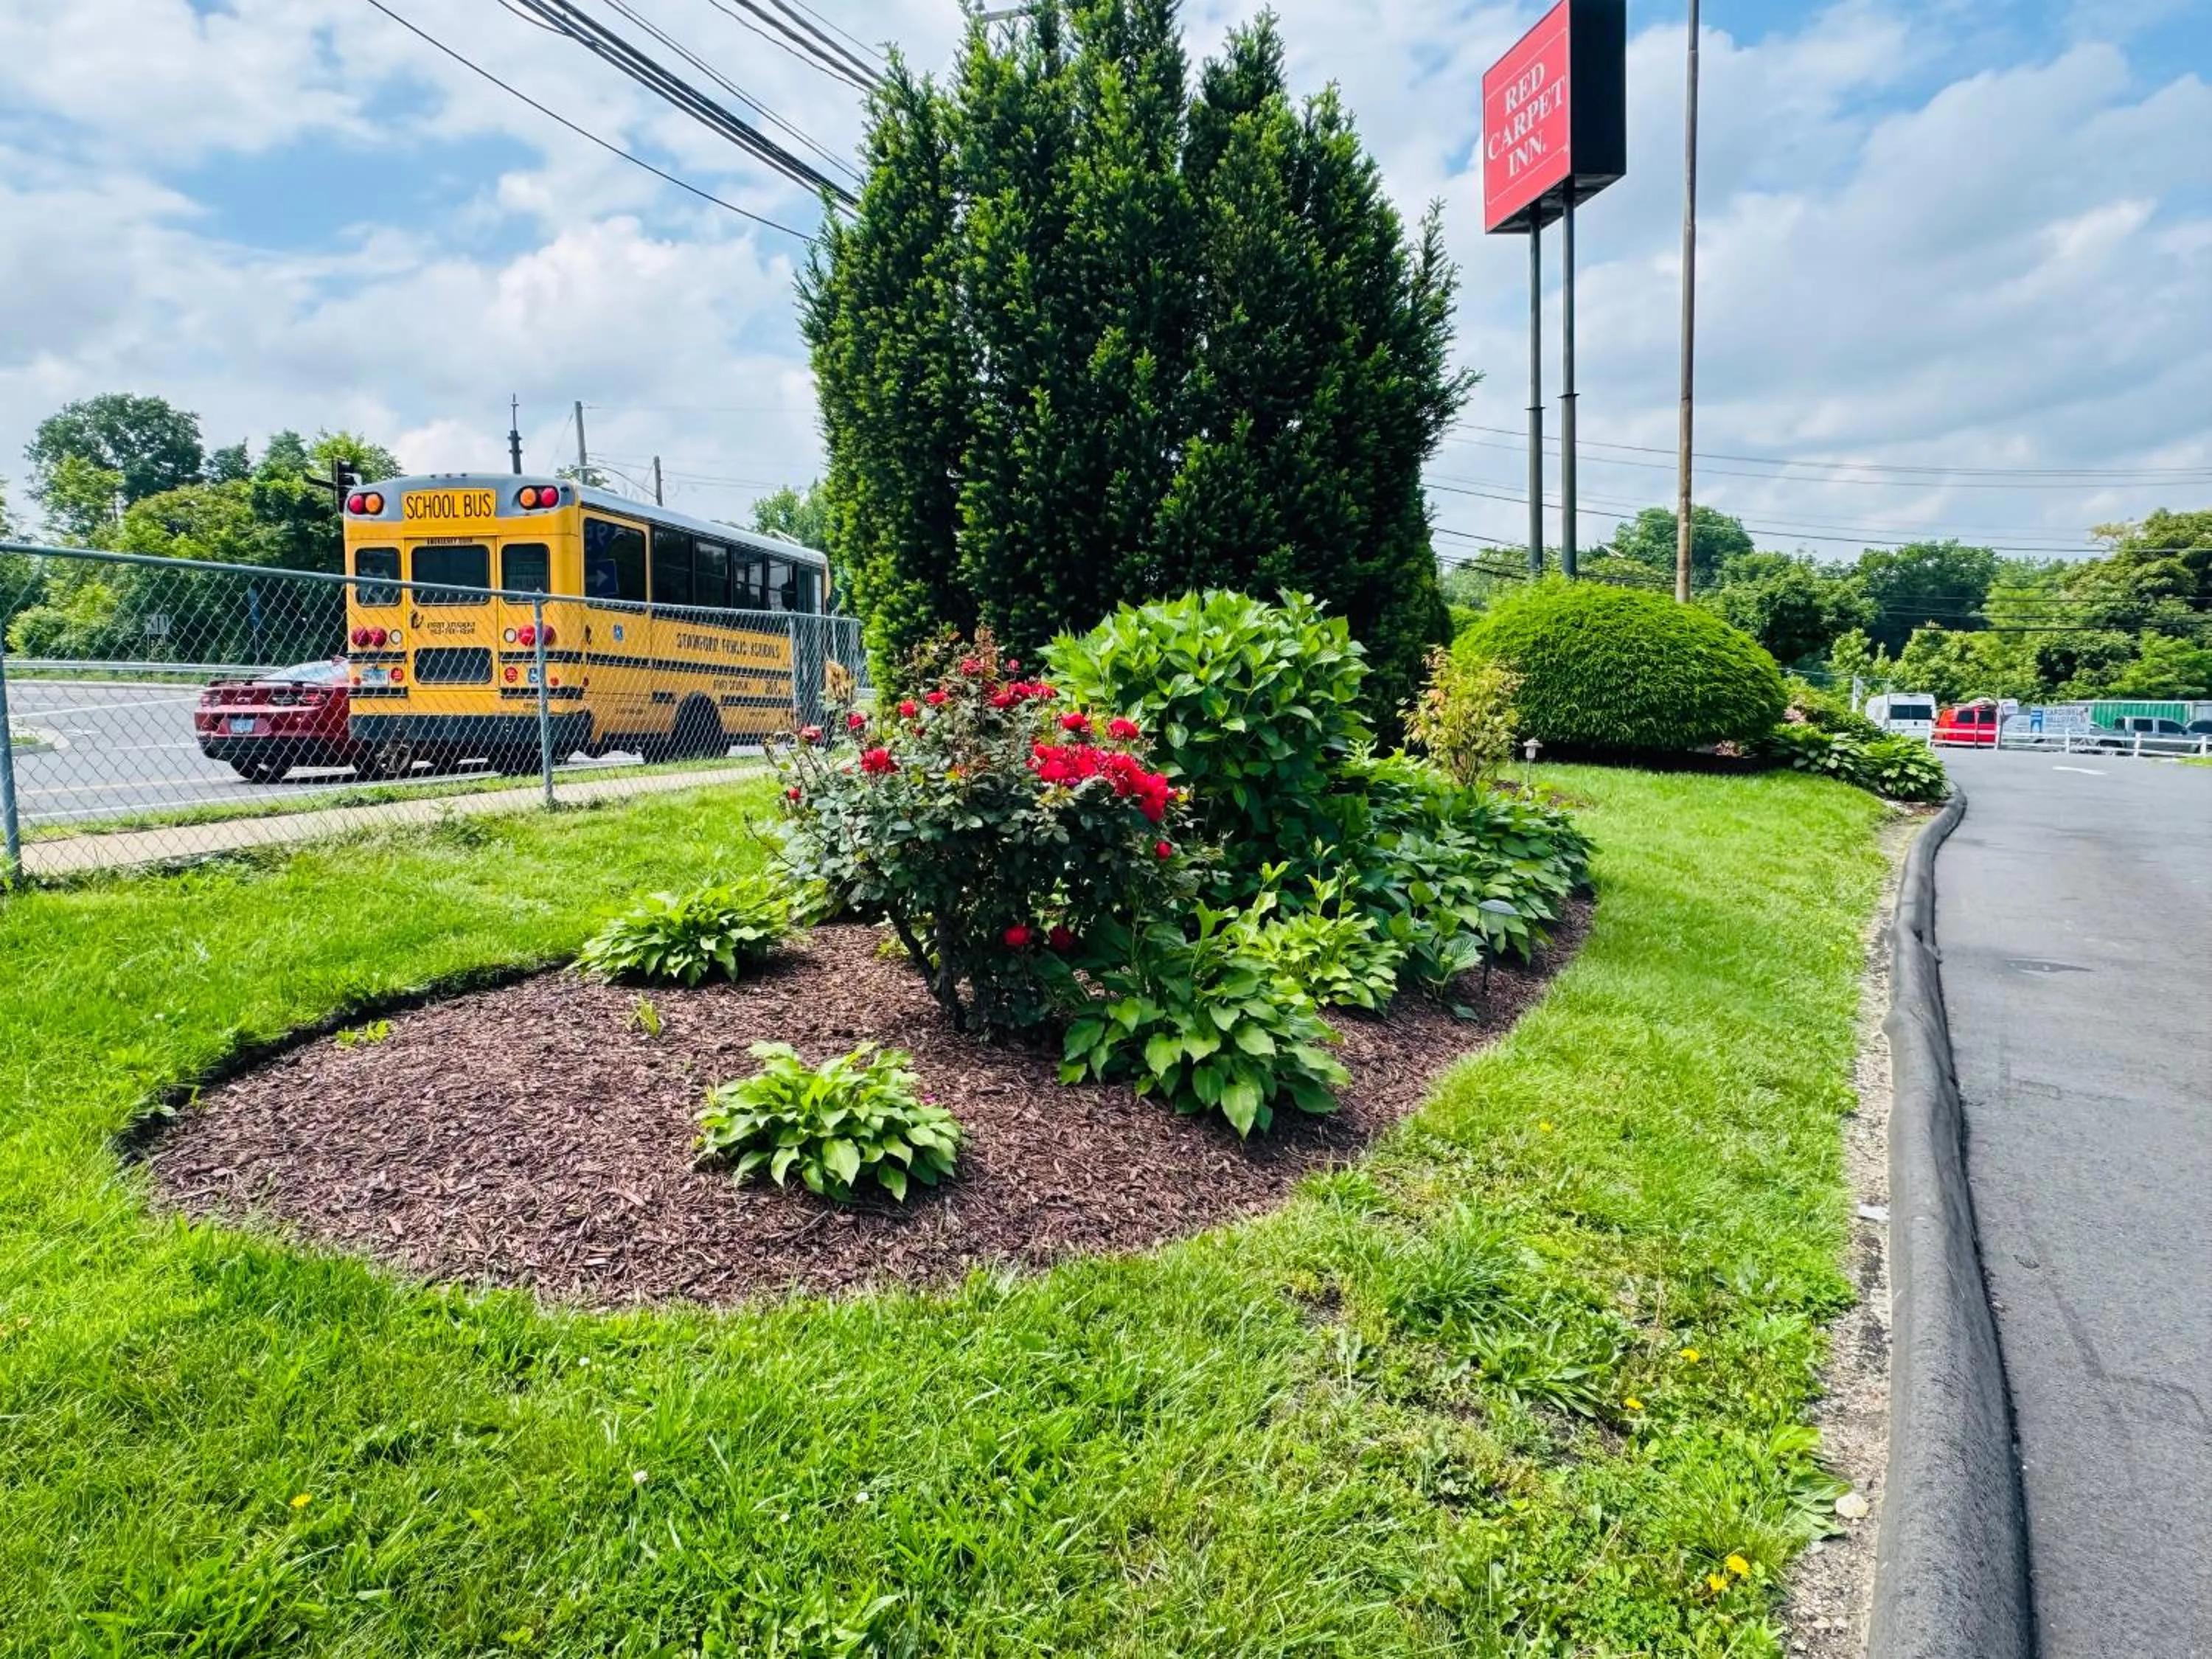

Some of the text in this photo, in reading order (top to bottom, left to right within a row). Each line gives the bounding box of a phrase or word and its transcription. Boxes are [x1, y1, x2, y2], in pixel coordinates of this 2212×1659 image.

[1504, 62, 1545, 116] RED
[1486, 74, 1566, 161] CARPET
[406, 493, 492, 519] SCHOOL BUS
